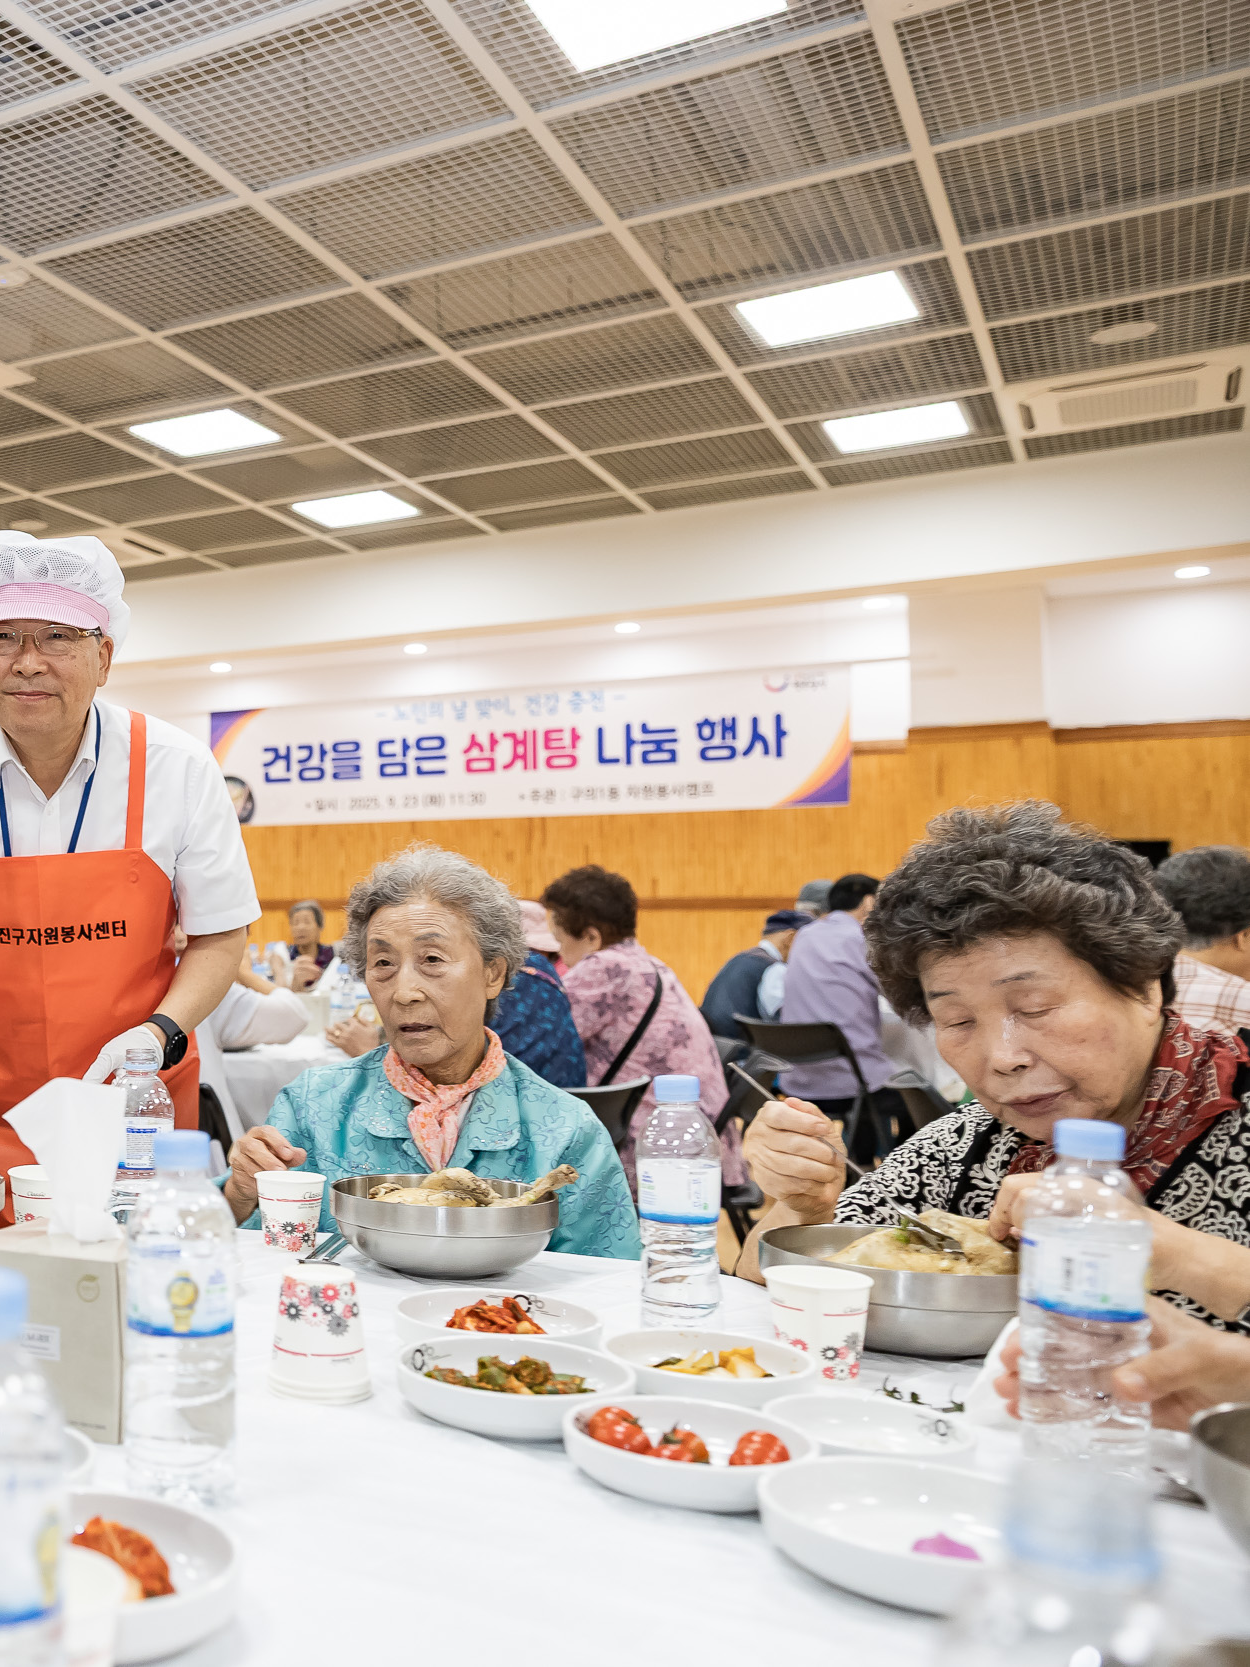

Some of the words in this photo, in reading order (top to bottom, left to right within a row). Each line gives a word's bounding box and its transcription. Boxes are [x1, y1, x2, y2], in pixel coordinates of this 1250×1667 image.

[452, 698, 468, 722] 날
[526, 692, 559, 716] 건강
[262, 741, 362, 783] 건강을
[377, 735, 447, 778] 담은
[463, 726, 582, 773] 삼계탕
[597, 723, 678, 765] 나눔
[696, 713, 788, 761] 행사
